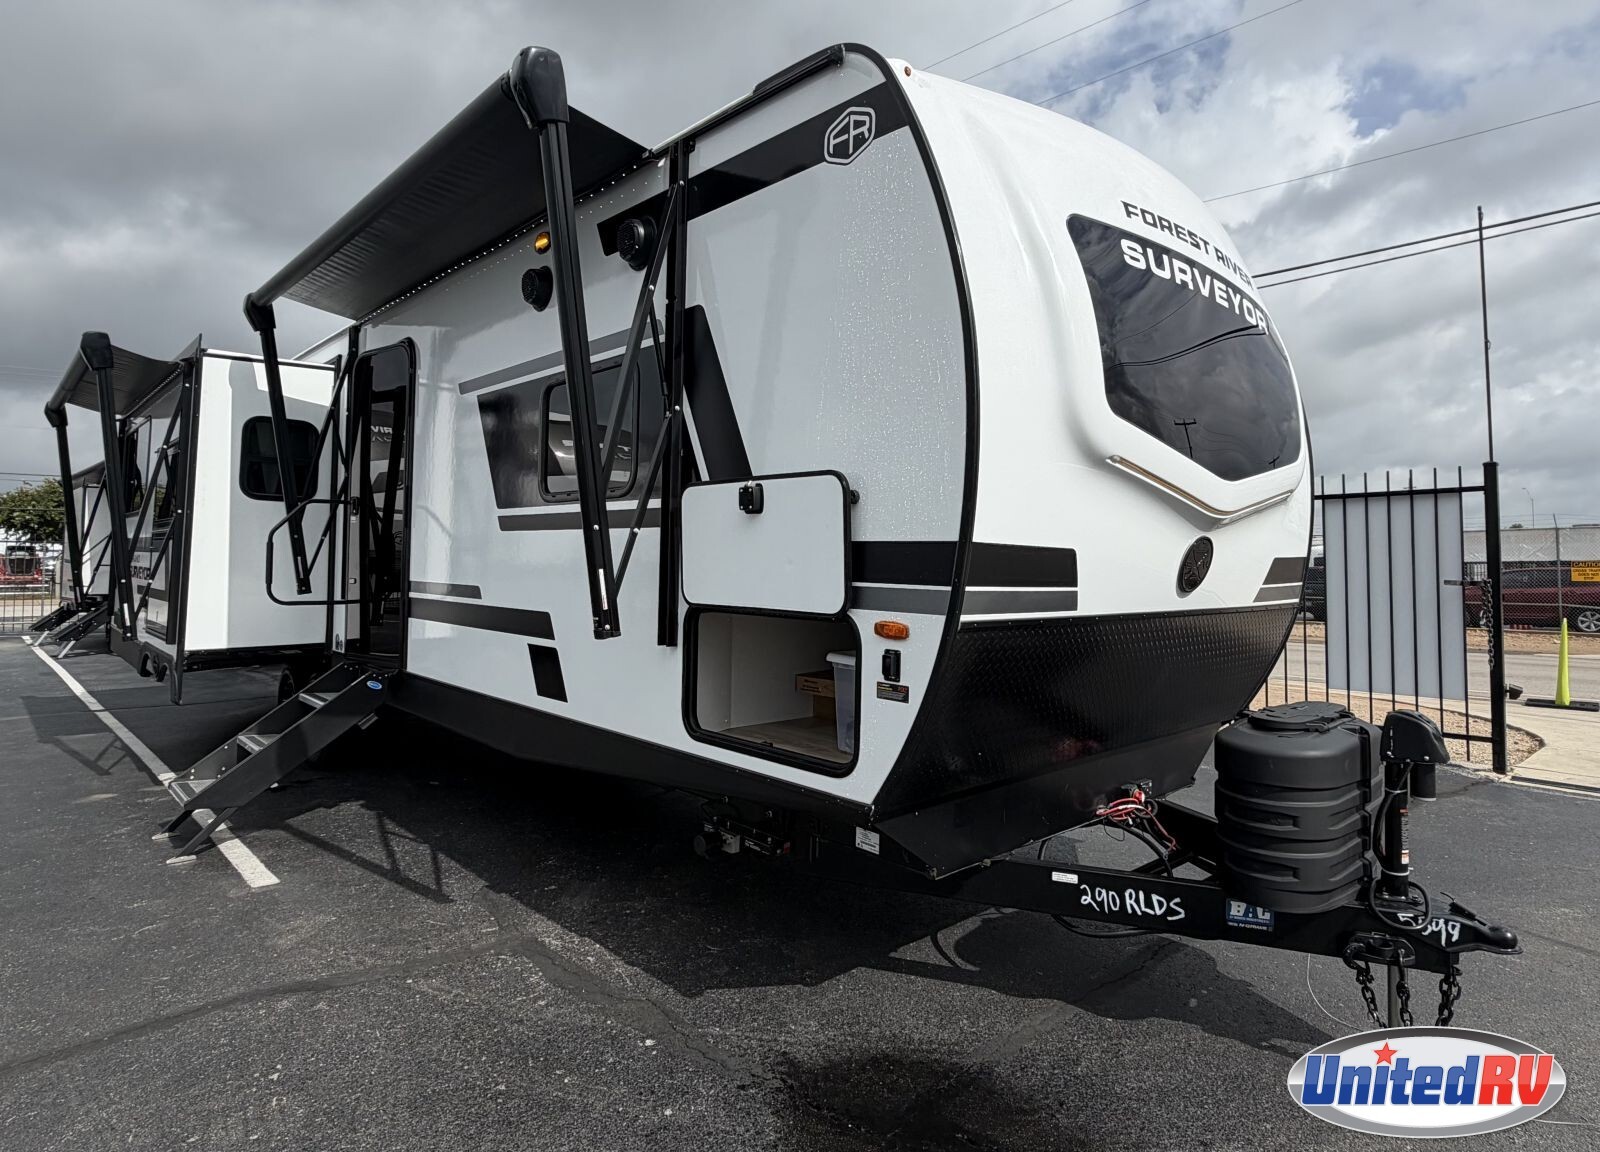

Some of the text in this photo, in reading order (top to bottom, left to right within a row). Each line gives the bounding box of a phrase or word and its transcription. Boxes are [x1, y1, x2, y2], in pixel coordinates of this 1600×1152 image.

[1120, 238, 1269, 336] SURVEYOR
[1121, 200, 1256, 291] FOREST RIVER
[1080, 884, 1186, 921] 290 RLDS
